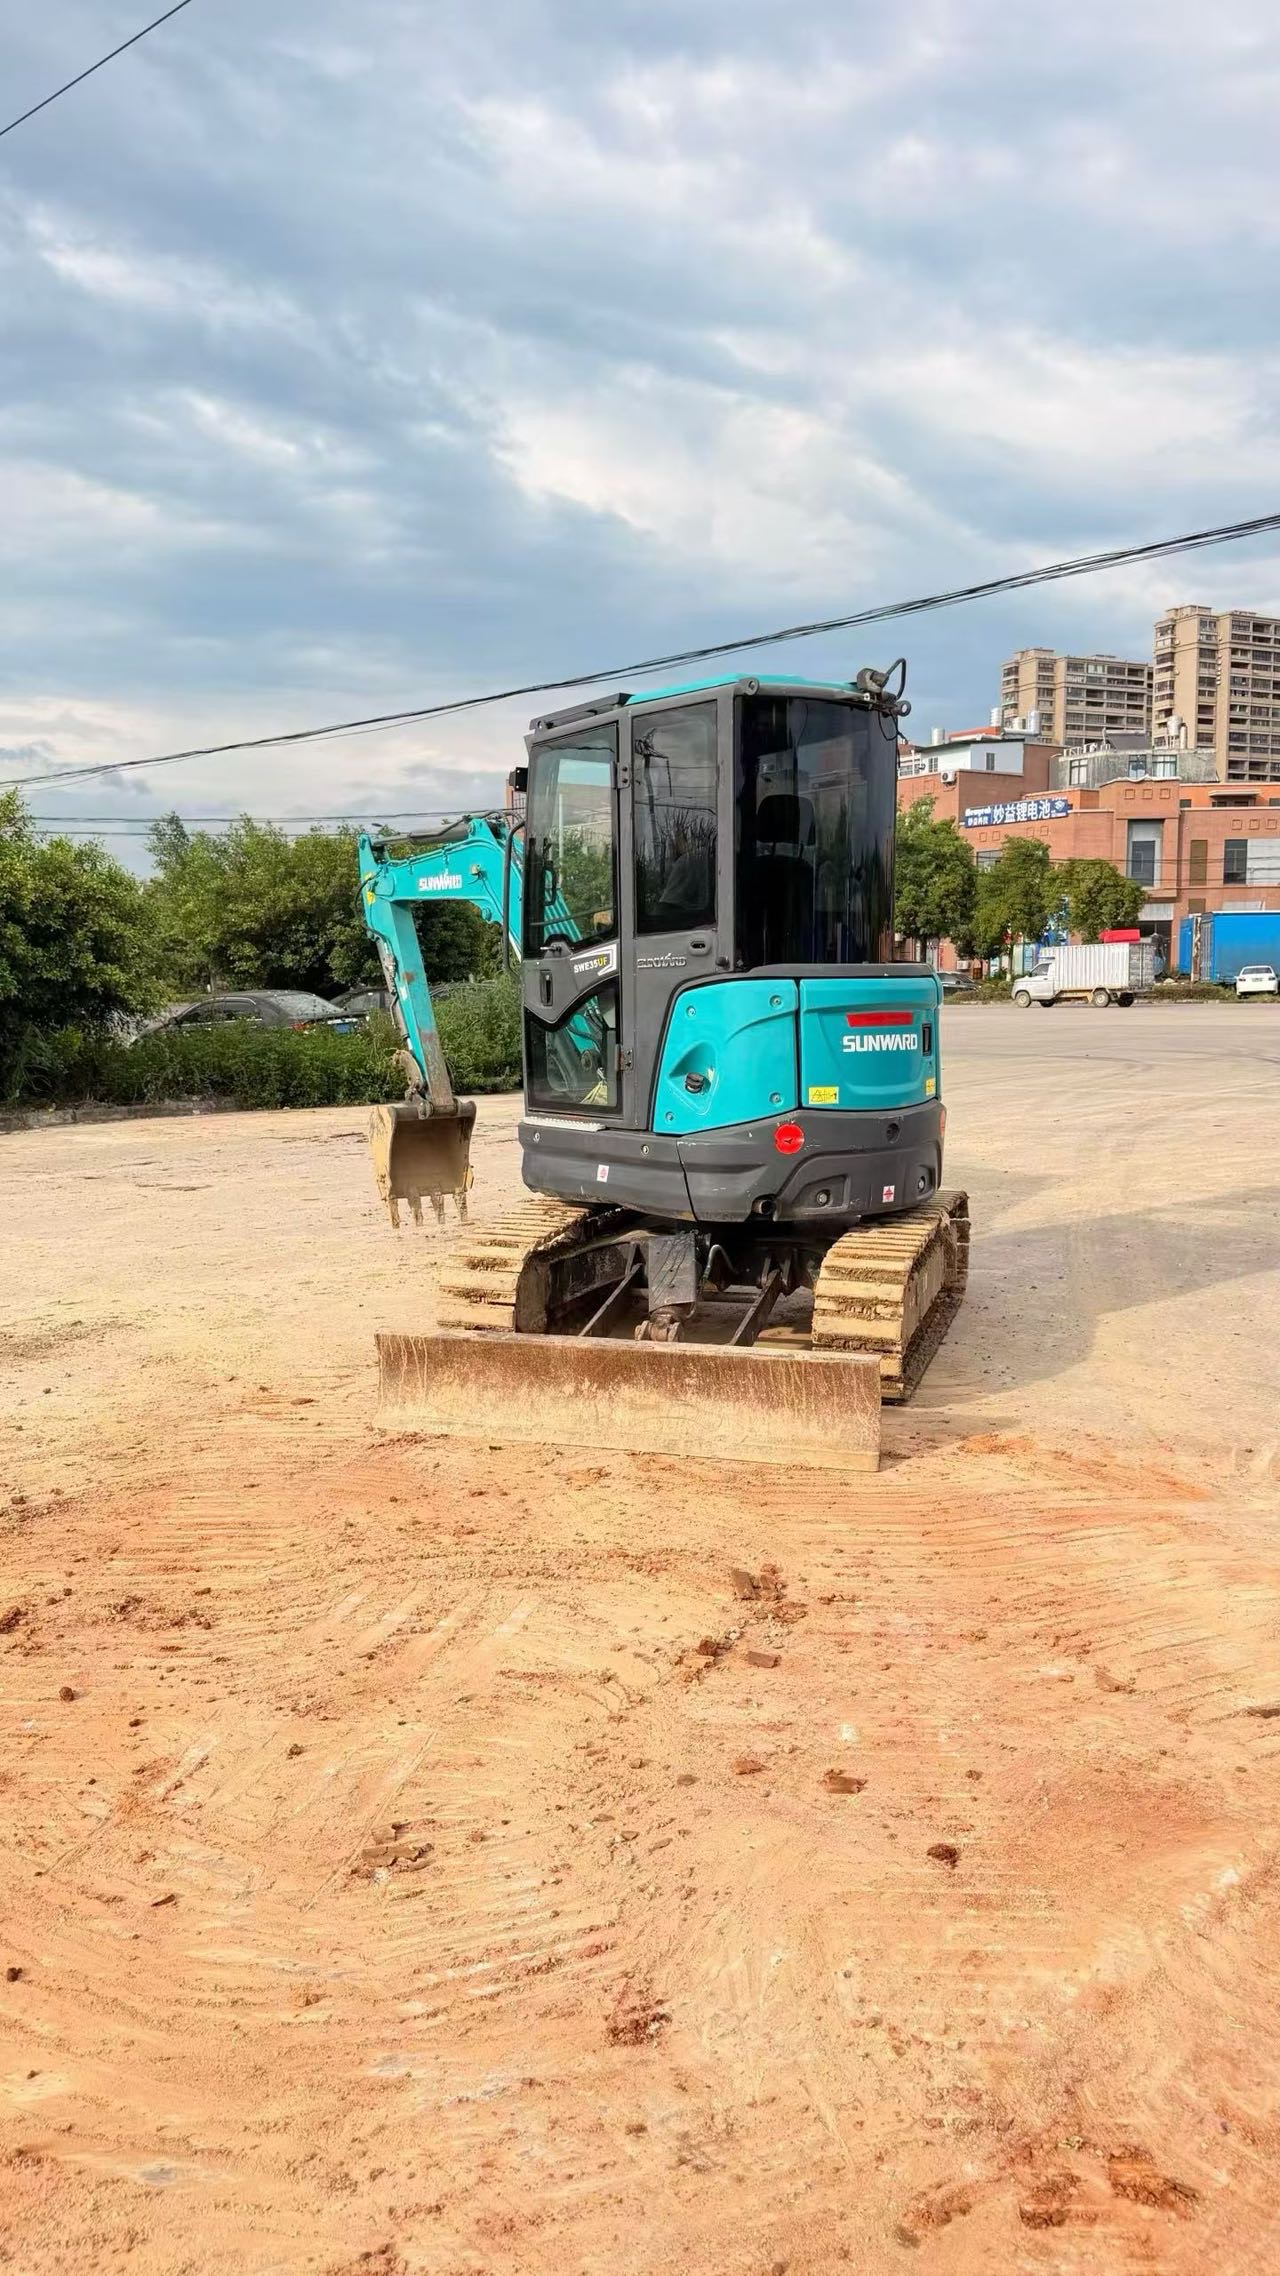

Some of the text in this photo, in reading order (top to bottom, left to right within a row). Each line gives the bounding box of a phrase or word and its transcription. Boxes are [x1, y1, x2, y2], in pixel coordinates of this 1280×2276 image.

[993, 801, 1050, 824] 妙益锂电池
[573, 955, 607, 973] SWE35UF
[843, 1034, 917, 1052] SUNWARD
